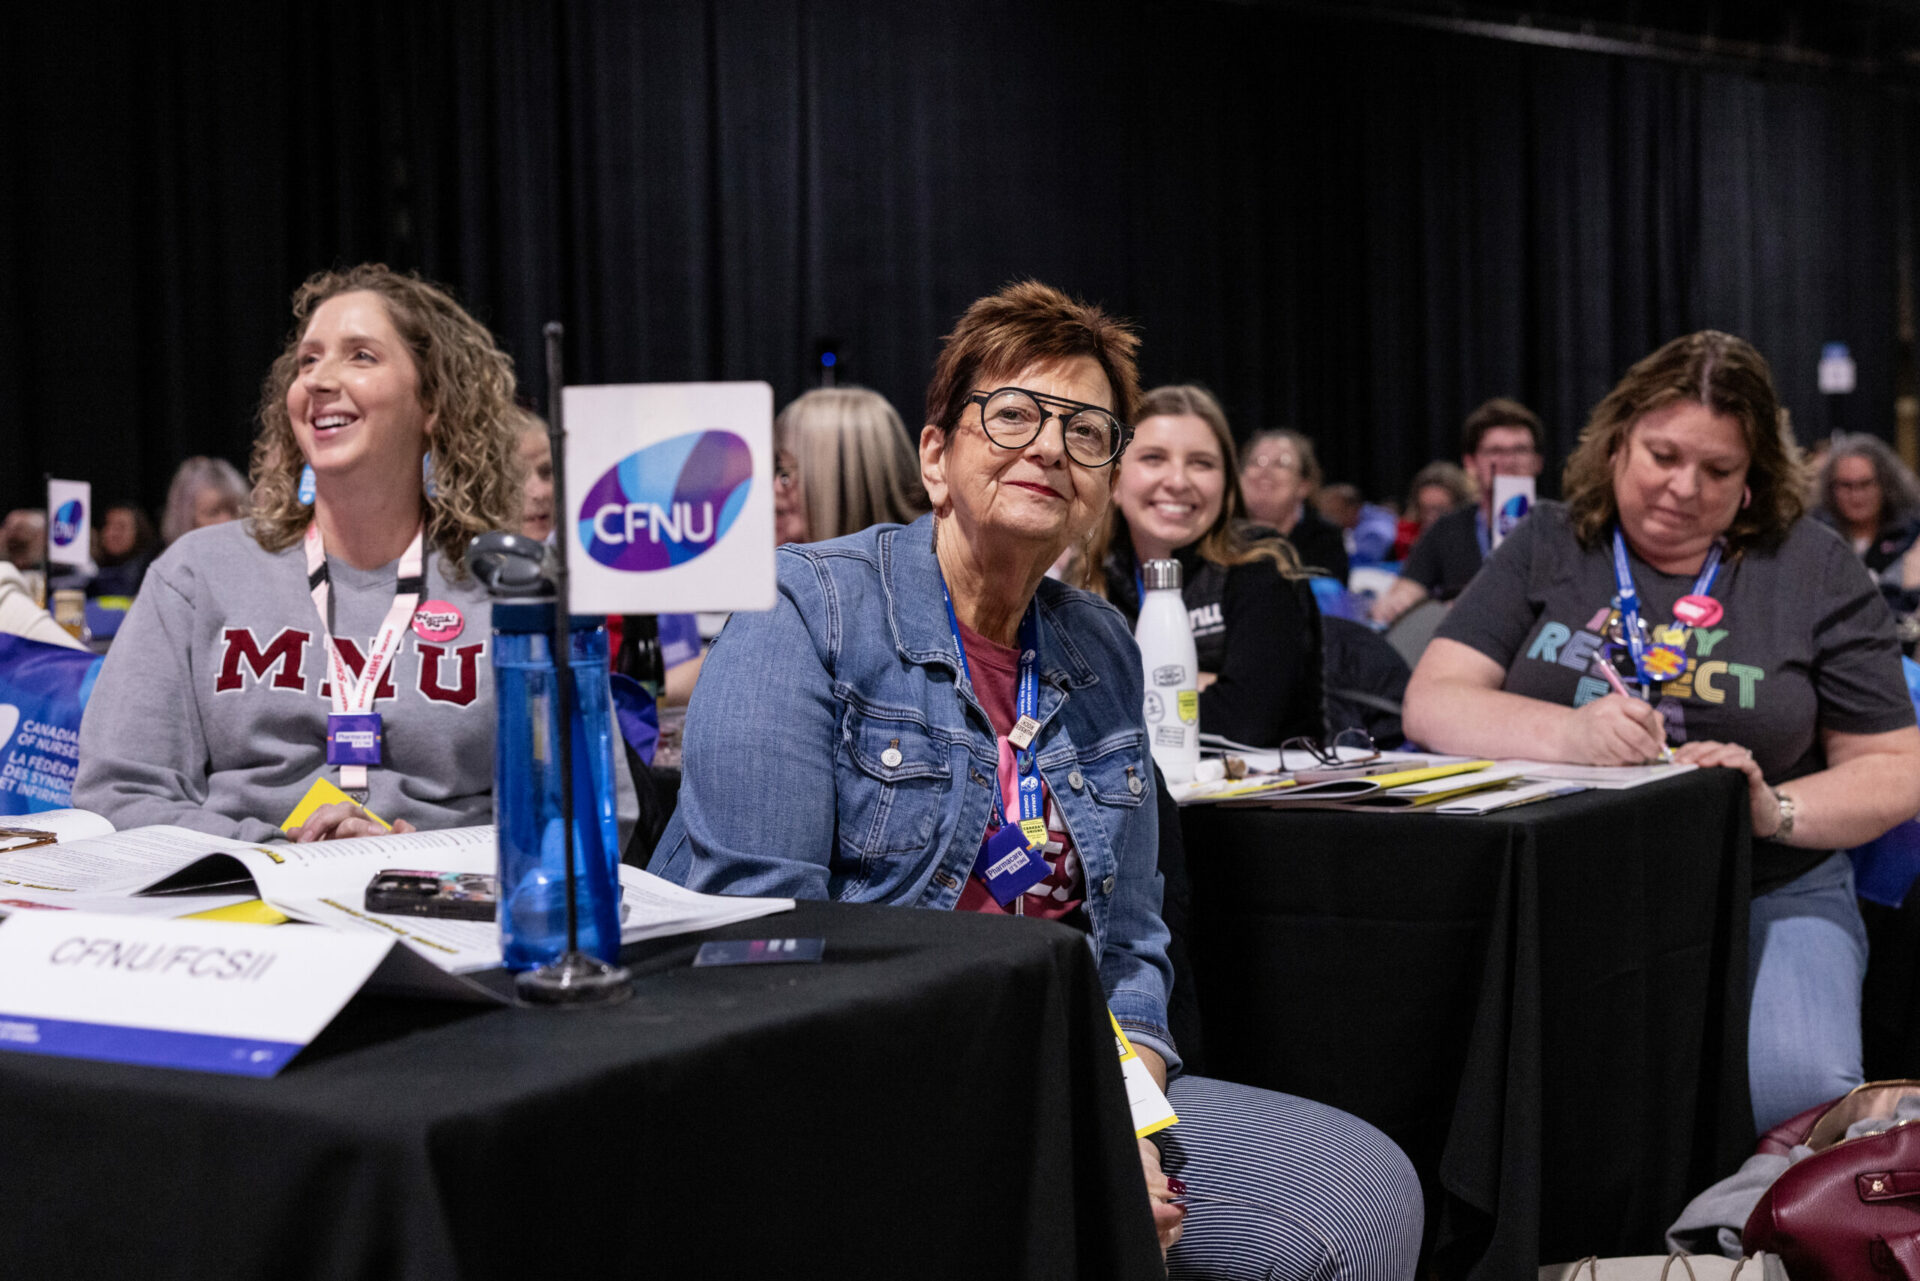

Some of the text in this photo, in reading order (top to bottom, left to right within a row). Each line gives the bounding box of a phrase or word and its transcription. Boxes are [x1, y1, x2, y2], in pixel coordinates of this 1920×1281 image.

[593, 502, 714, 545] CFNU
[369, 654, 383, 682] SHIFT
[1526, 621, 1765, 709] REECT
[17, 732, 37, 747] OF
[8, 750, 26, 766] LA
[3, 763, 30, 781] DES
[0, 775, 17, 792] ET
[987, 850, 1024, 877] Pharmacare
